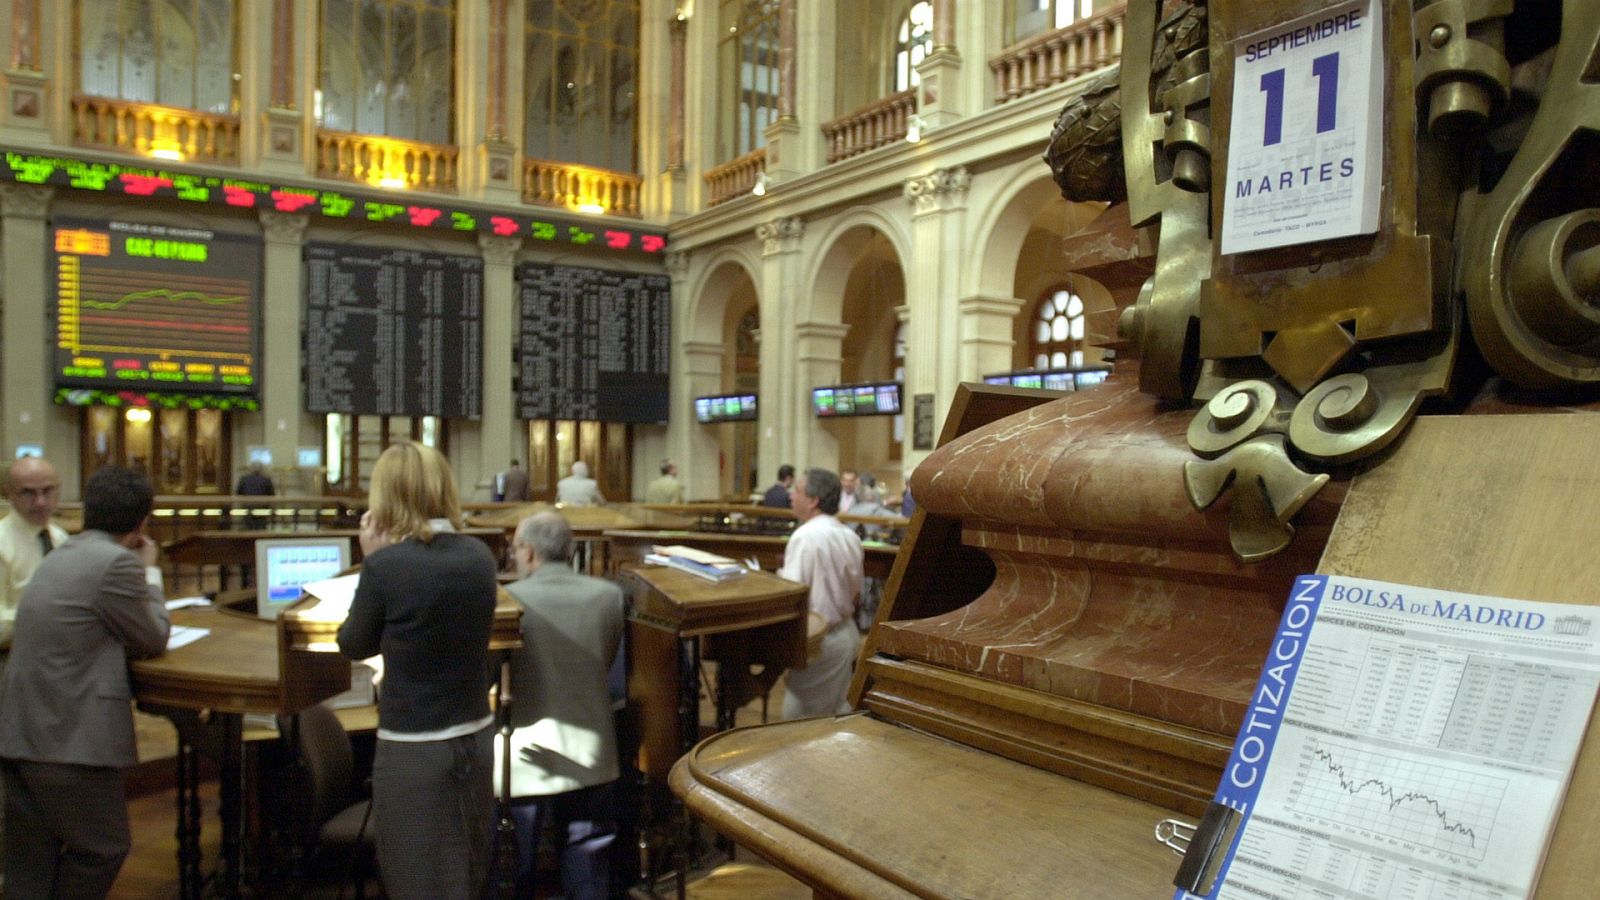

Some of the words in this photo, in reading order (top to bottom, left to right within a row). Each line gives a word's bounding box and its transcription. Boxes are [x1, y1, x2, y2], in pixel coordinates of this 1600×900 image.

[1246, 9, 1361, 62] SEPTIEMBRE
[1260, 51, 1340, 147] 11
[1236, 158, 1354, 198] MARTES
[1331, 584, 1405, 611] BOLSA
[1410, 603, 1430, 616] DE
[1432, 600, 1545, 631] MADRID
[1359, 623, 1405, 636] COTIZACION
[1231, 579, 1321, 788] COTIZACION
